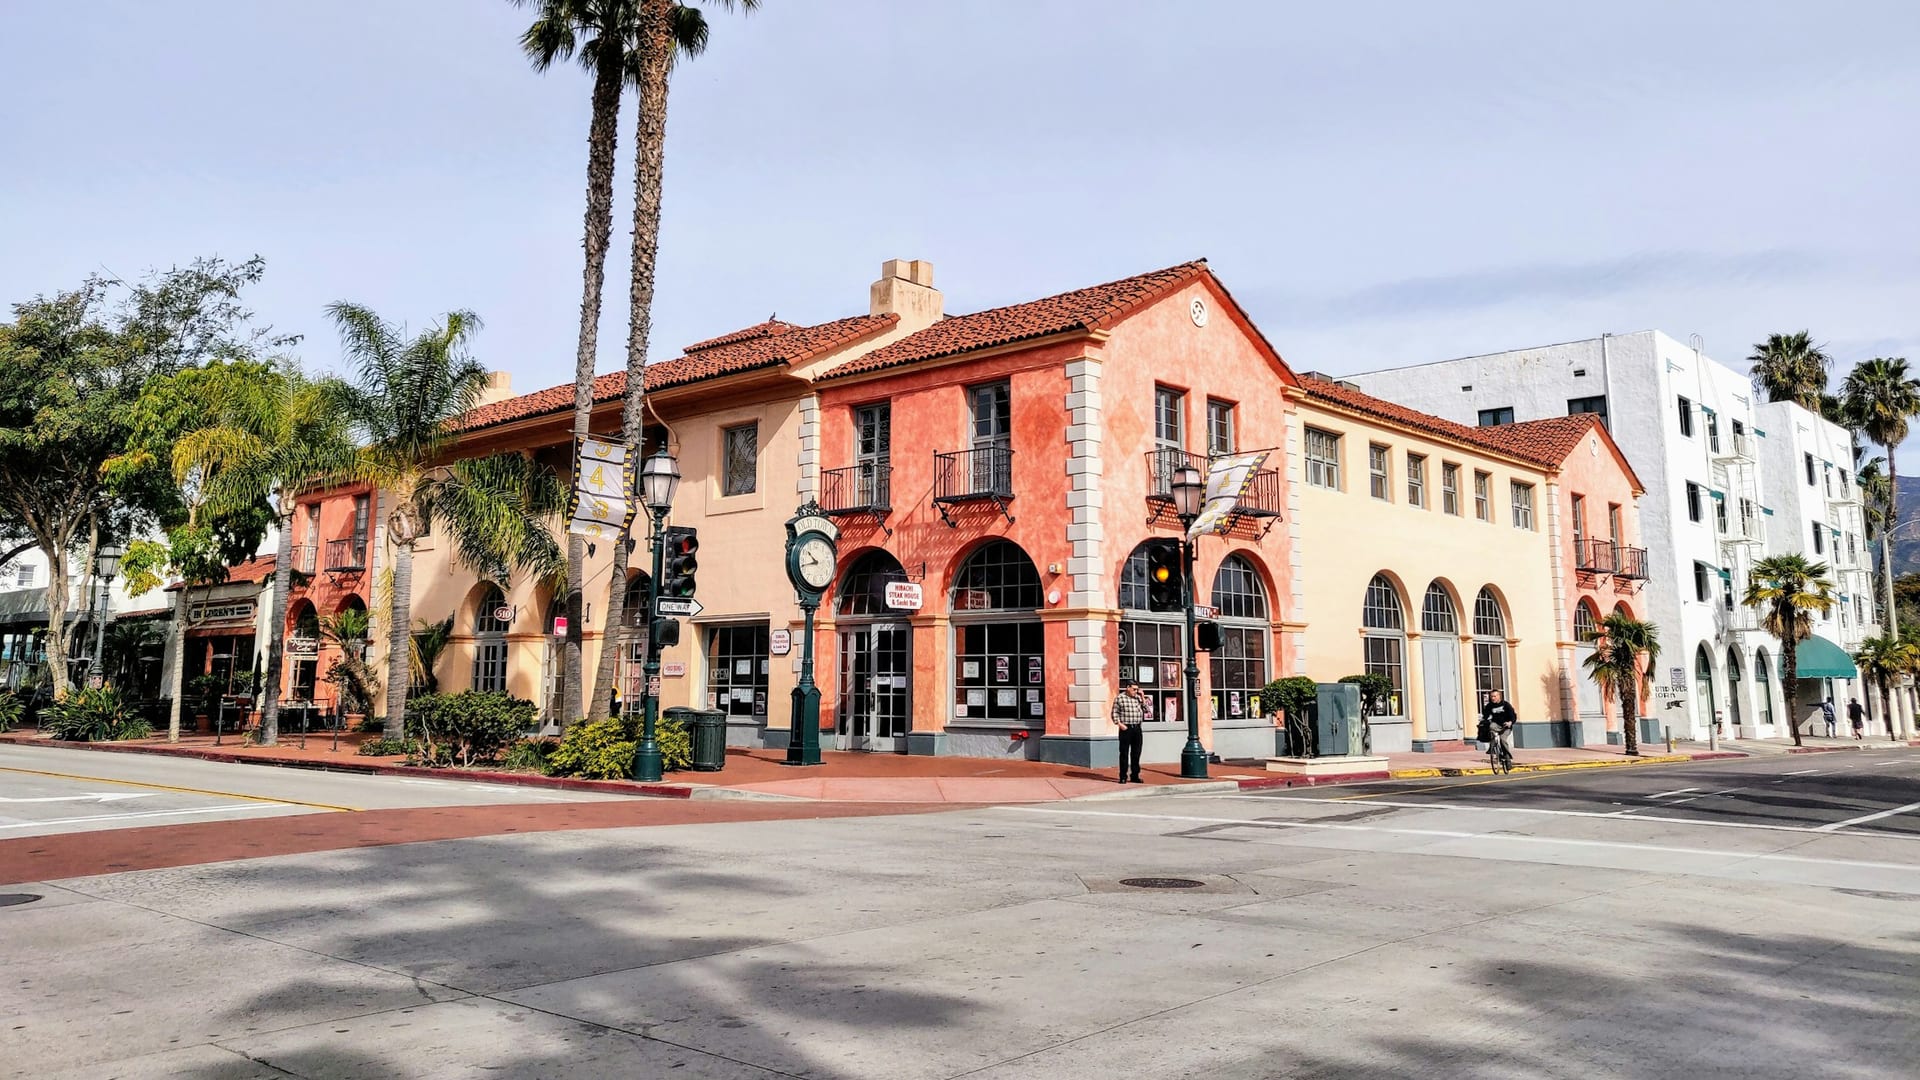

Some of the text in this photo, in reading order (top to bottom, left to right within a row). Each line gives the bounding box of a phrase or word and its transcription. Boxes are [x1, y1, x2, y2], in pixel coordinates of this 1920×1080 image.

[589, 465, 605, 491] 4
[592, 501, 609, 519] 3
[797, 518, 834, 536] OLD TOWN
[194, 608, 235, 618] HLDREN'S
[677, 603, 690, 611] WAY
[497, 609, 511, 618] 510
[711, 668, 729, 680] OPEN
